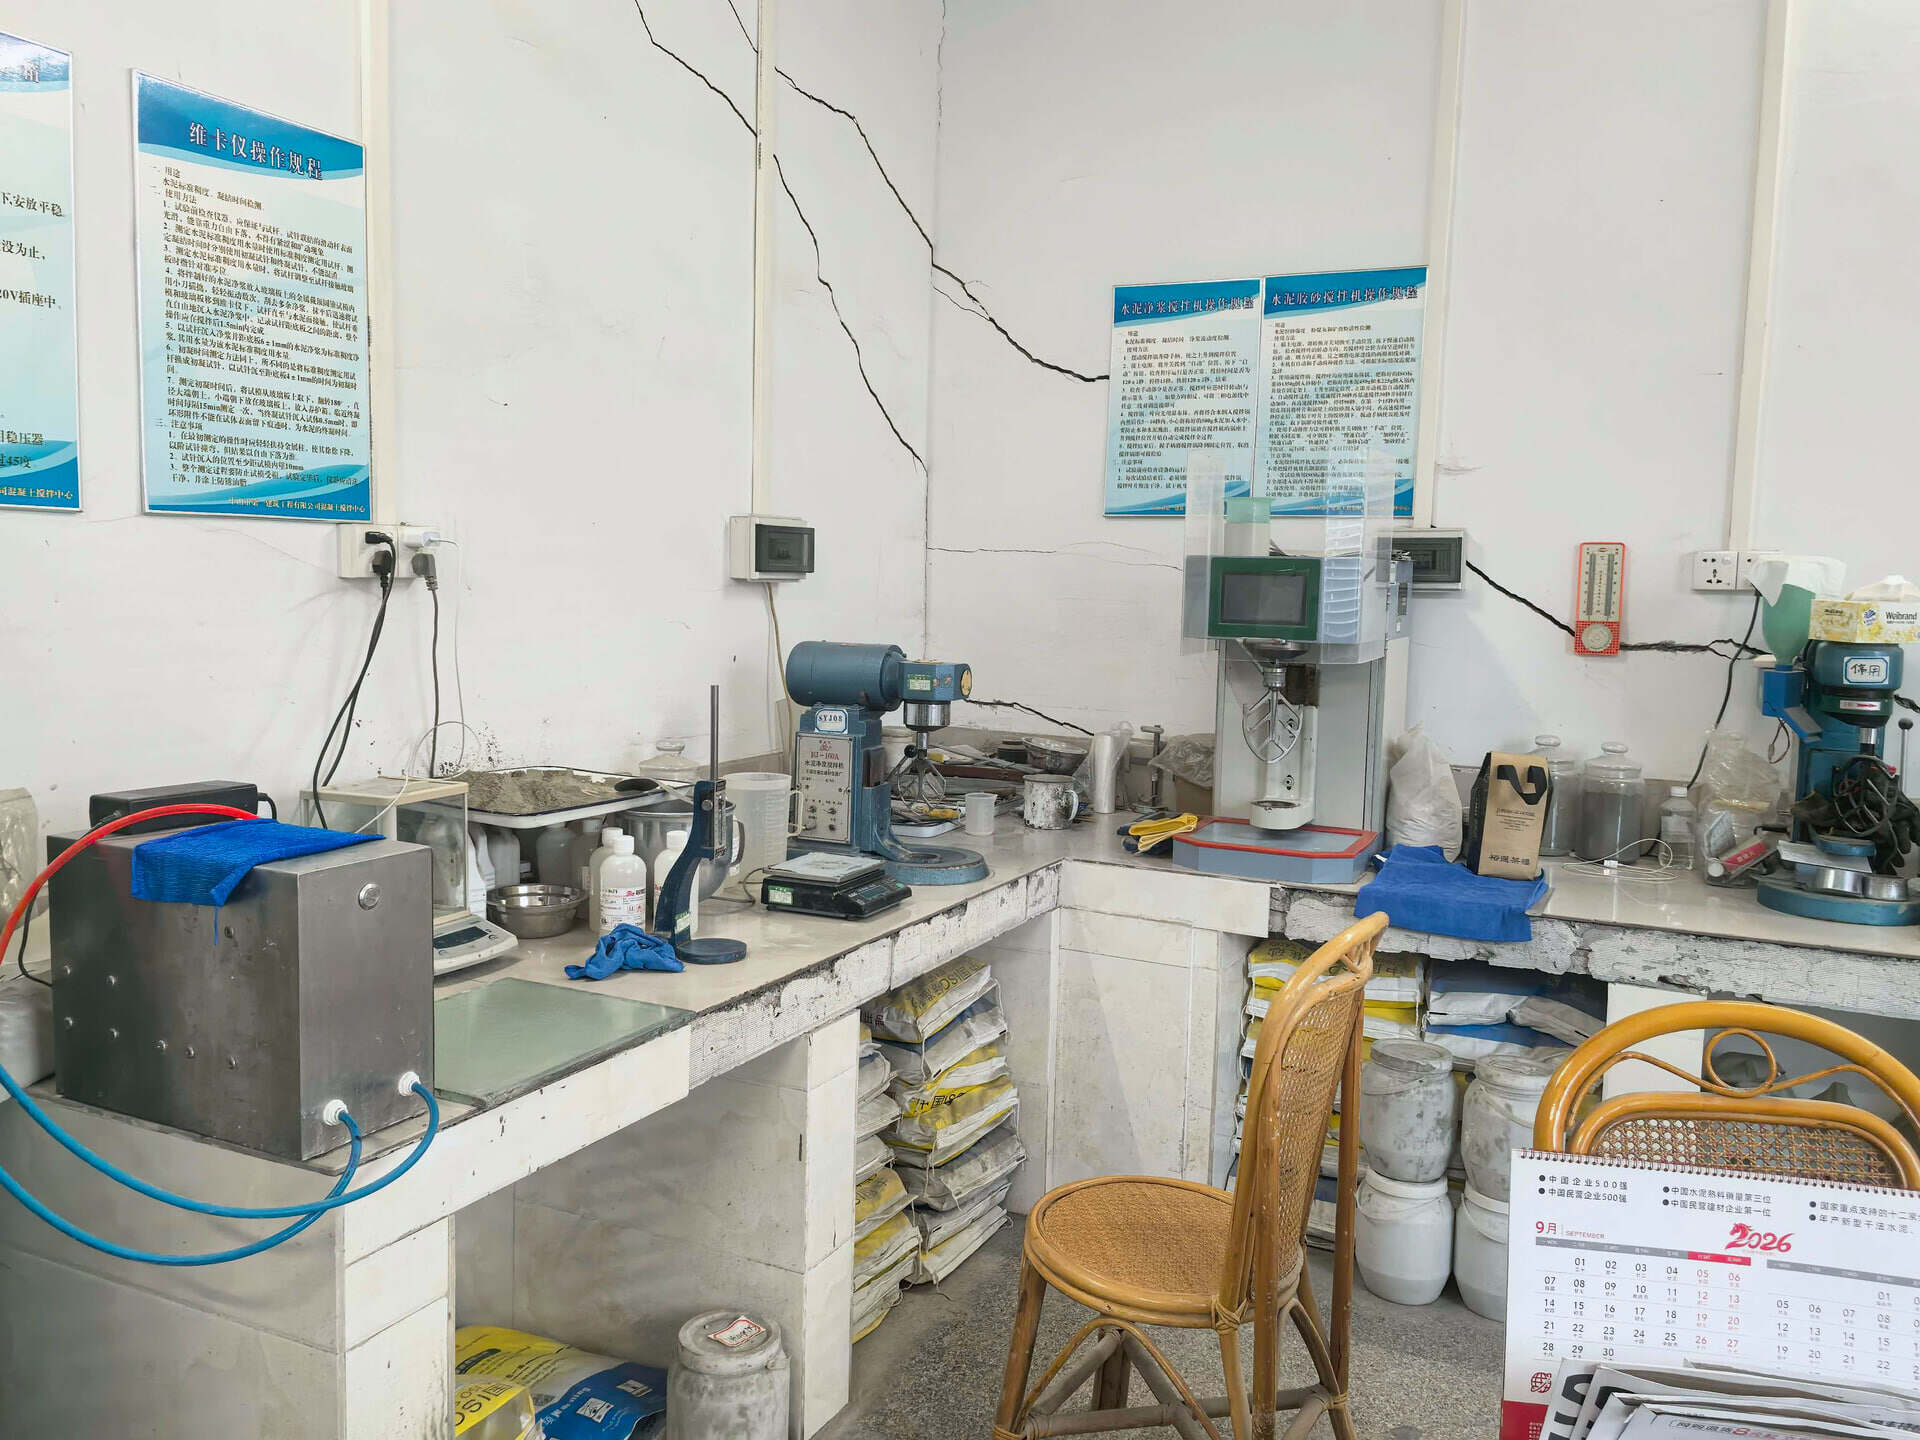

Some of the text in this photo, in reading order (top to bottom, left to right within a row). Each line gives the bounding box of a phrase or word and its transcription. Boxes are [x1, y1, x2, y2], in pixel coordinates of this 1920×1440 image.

[189, 119, 322, 182] 维卡仪操作规程
[1121, 296, 1254, 315] 水泥净浆搅拌机操作规程
[1271, 284, 1418, 308] 水泥胶砂搅拌机操作规程
[1851, 663, 1880, 677] 停用
[1549, 1175, 1628, 1190] 中国企业500强
[1548, 1188, 1627, 1203] 中国民营企业500强
[1820, 1201, 1920, 1221] 国家重点支持的十二家
[1536, 1221, 1557, 1235] 9月
[1725, 1222, 1794, 1252] 2026
[1575, 1257, 1585, 1266] 01
[1605, 1261, 1617, 1269] 02
[1635, 1264, 1647, 1272] 03
[1697, 1269, 1709, 1278] 05
[1729, 1273, 1740, 1281] 06
[1544, 1276, 1740, 1303] 07 08 09 10 11 12 13
[1878, 1291, 1890, 1300] 01
[1544, 1299, 1740, 1325] 14 15 16 17 18 19 20
[1777, 1300, 1789, 1309] 05
[1808, 1304, 1821, 1313] 06
[1842, 1308, 1855, 1318] 07
[1877, 1314, 1890, 1323] 08
[1544, 1321, 1738, 1348] 21 22 23 24 25 26 27
[1777, 1323, 1789, 1332] 12
[1809, 1327, 1821, 1336] 13
[1843, 1332, 1855, 1341] 14
[1878, 1337, 1890, 1346] 15
[1542, 1342, 1614, 1356] 28 29 30
[1777, 1345, 1788, 1354] 19
[1808, 1349, 1821, 1359] 20
[1842, 1354, 1855, 1364] 21
[1877, 1360, 1890, 1370] 22
